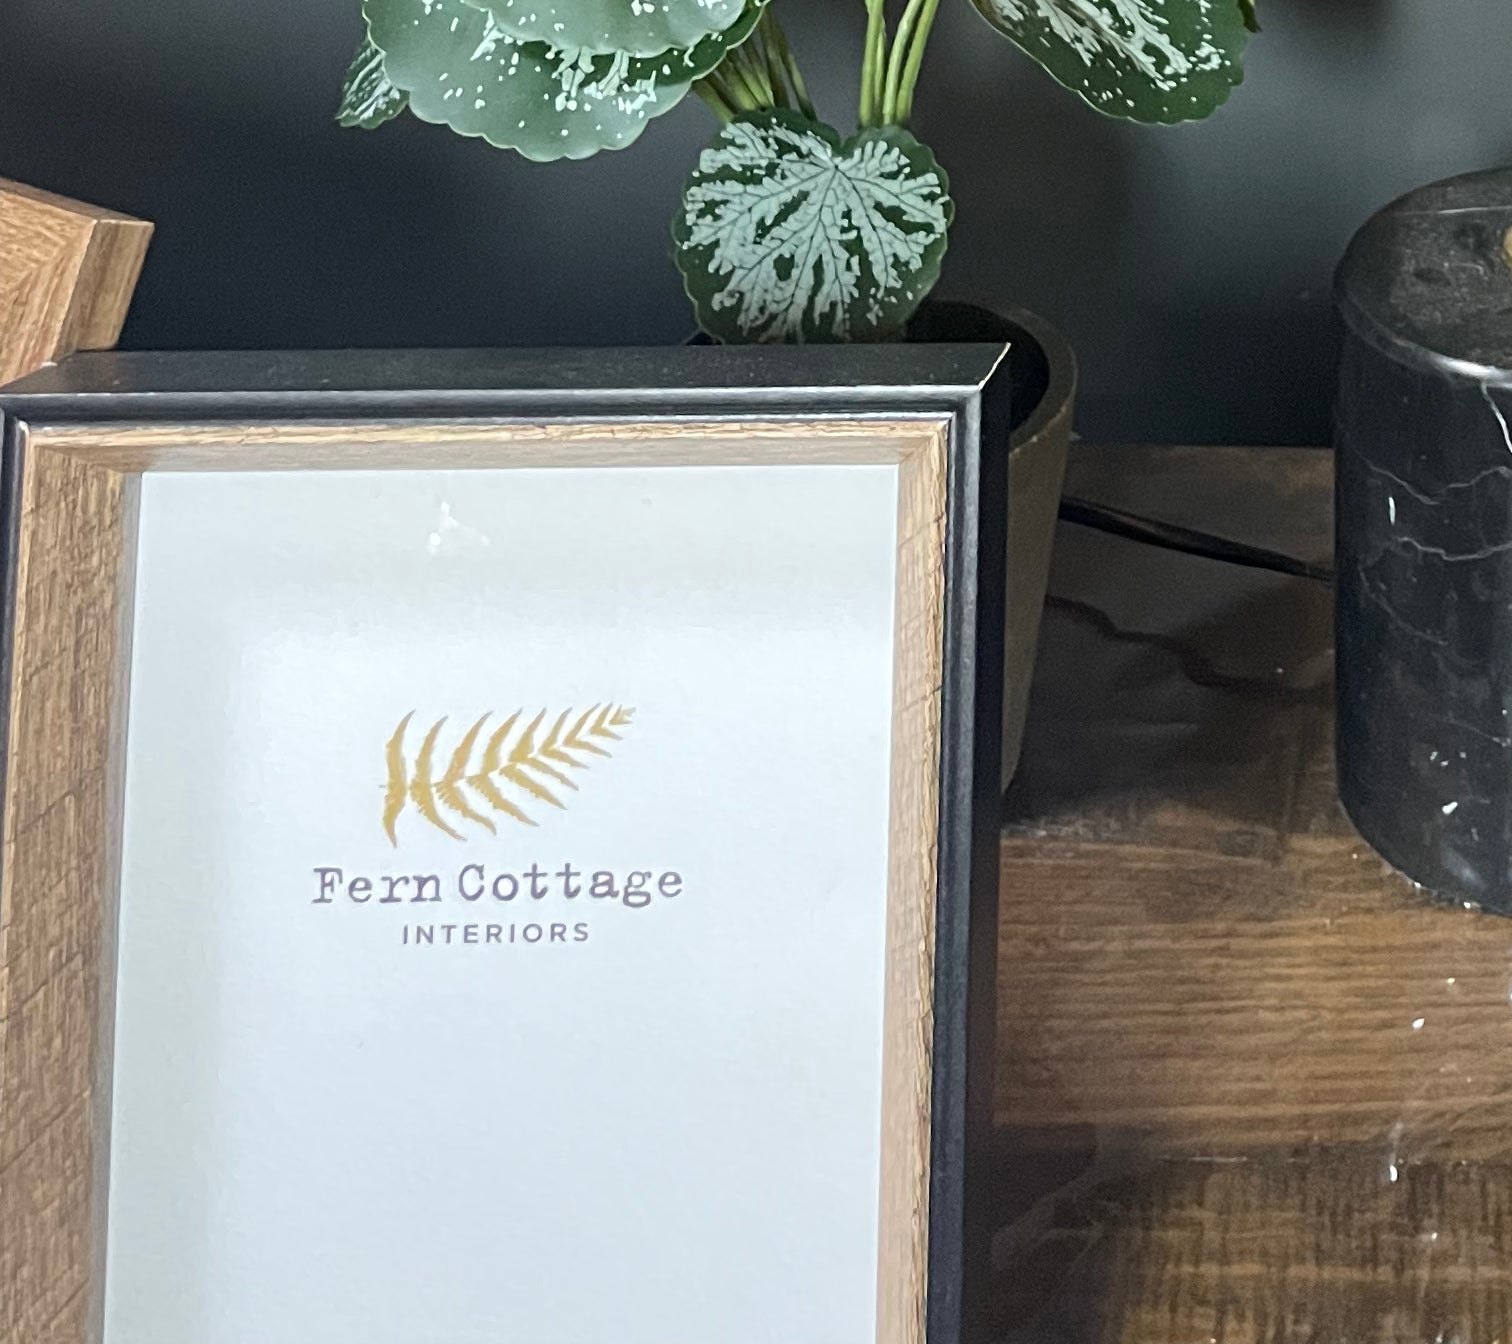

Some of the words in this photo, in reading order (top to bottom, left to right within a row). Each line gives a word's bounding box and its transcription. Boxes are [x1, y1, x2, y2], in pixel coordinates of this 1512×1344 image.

[311, 866, 443, 905] Fern
[457, 862, 684, 908] Cottage
[402, 921, 591, 946] INTERIORS
